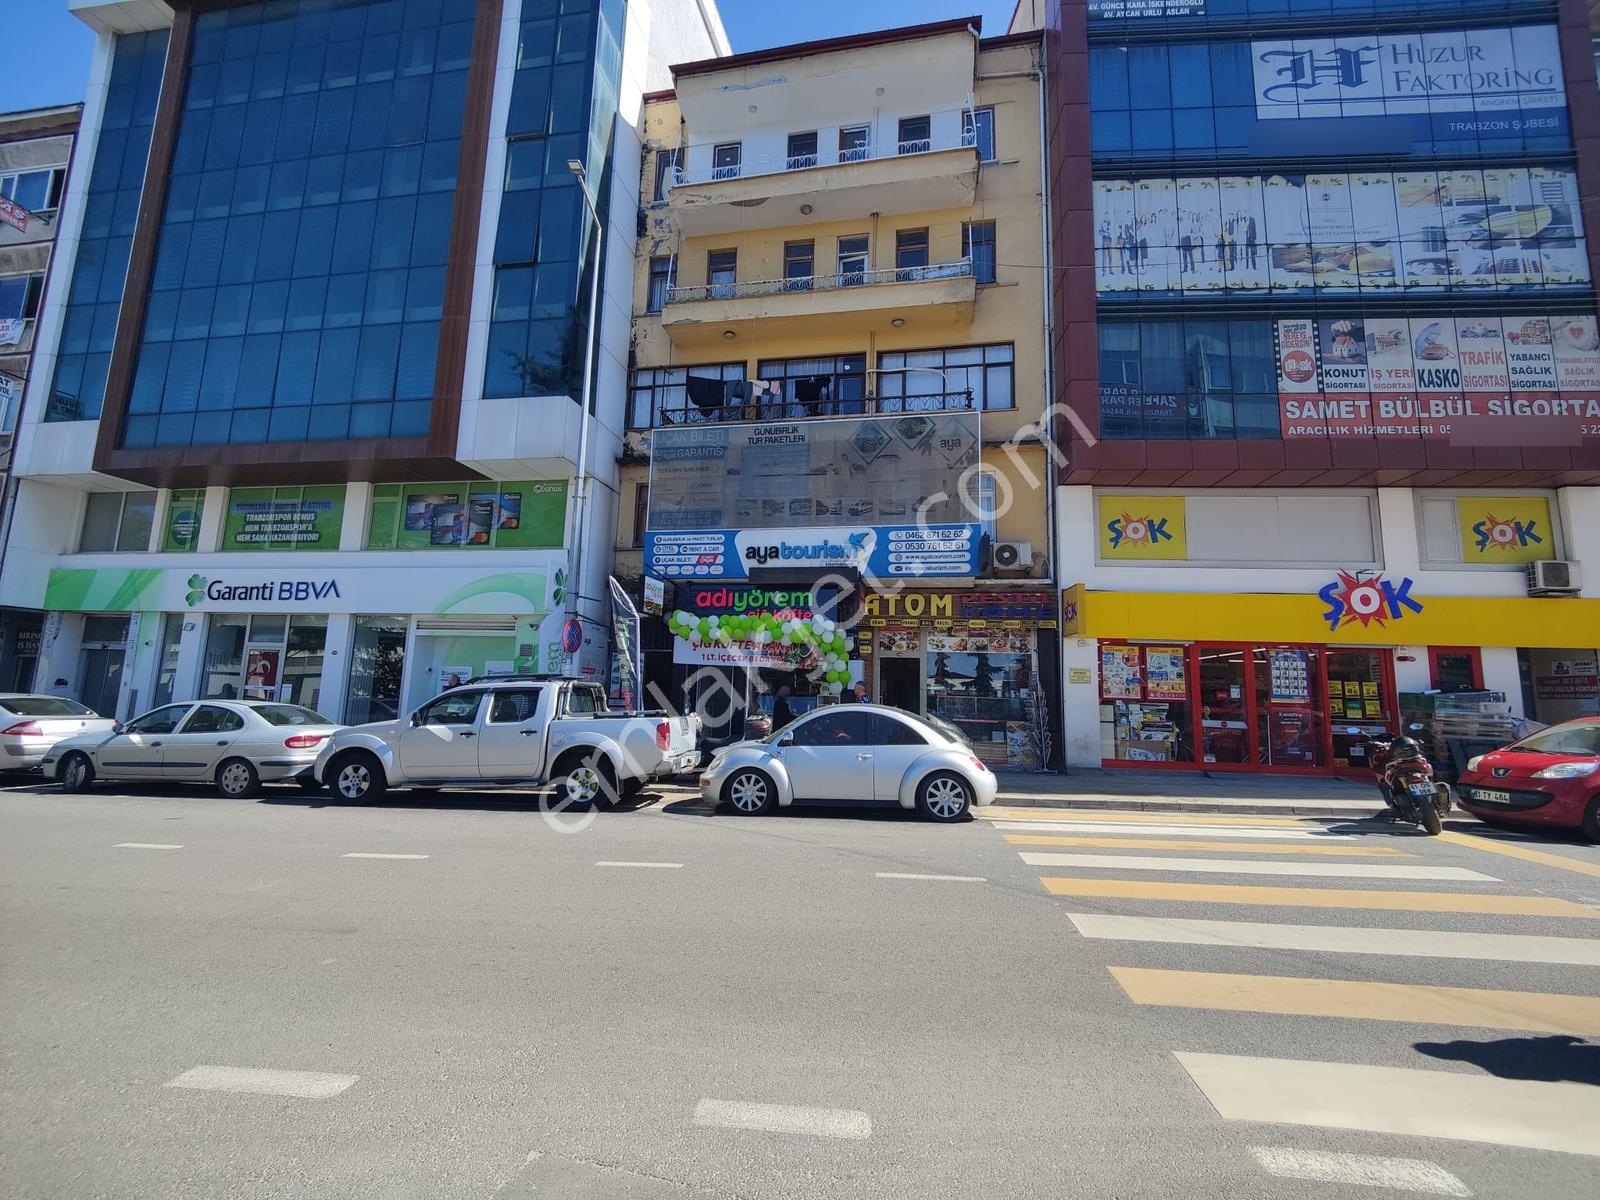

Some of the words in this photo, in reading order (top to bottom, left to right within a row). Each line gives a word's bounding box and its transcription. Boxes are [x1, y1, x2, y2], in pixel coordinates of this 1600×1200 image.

[1127, 1, 1147, 9] KARA
[1166, 8, 1190, 16] ASLAN
[1391, 43, 1485, 65] HUZUR
[1393, 67, 1554, 92] FAKTORİNG
[1449, 120, 1509, 131] TRABZON
[1460, 348, 1505, 365] TRAFİK
[1510, 353, 1551, 362] YABANCI
[1324, 368, 1366, 378] KONUT
[1386, 368, 1414, 378] YERİ
[1511, 365, 1552, 375] SAĞLIK
[1417, 368, 1460, 388] KASKO
[1463, 373, 1508, 388] SİGORTASI
[1511, 379, 1556, 389] SİGORTASI
[1286, 399, 1370, 419] SAMET
[1379, 397, 1480, 419] BÜLBÜL
[1287, 425, 1349, 435] ARACILIK
[1354, 423, 1434, 434] HİZMETLERİ
[748, 436, 763, 445] TUR
[940, 438, 961, 451] aya
[1107, 512, 1173, 549] ŞOK
[1472, 517, 1543, 553] ŞOK
[745, 540, 857, 564] ayatourism
[207, 580, 274, 600] Garanti
[278, 579, 341, 600] BBVA
[864, 594, 953, 617] ATOM
[1318, 568, 1424, 632] ŞOK
